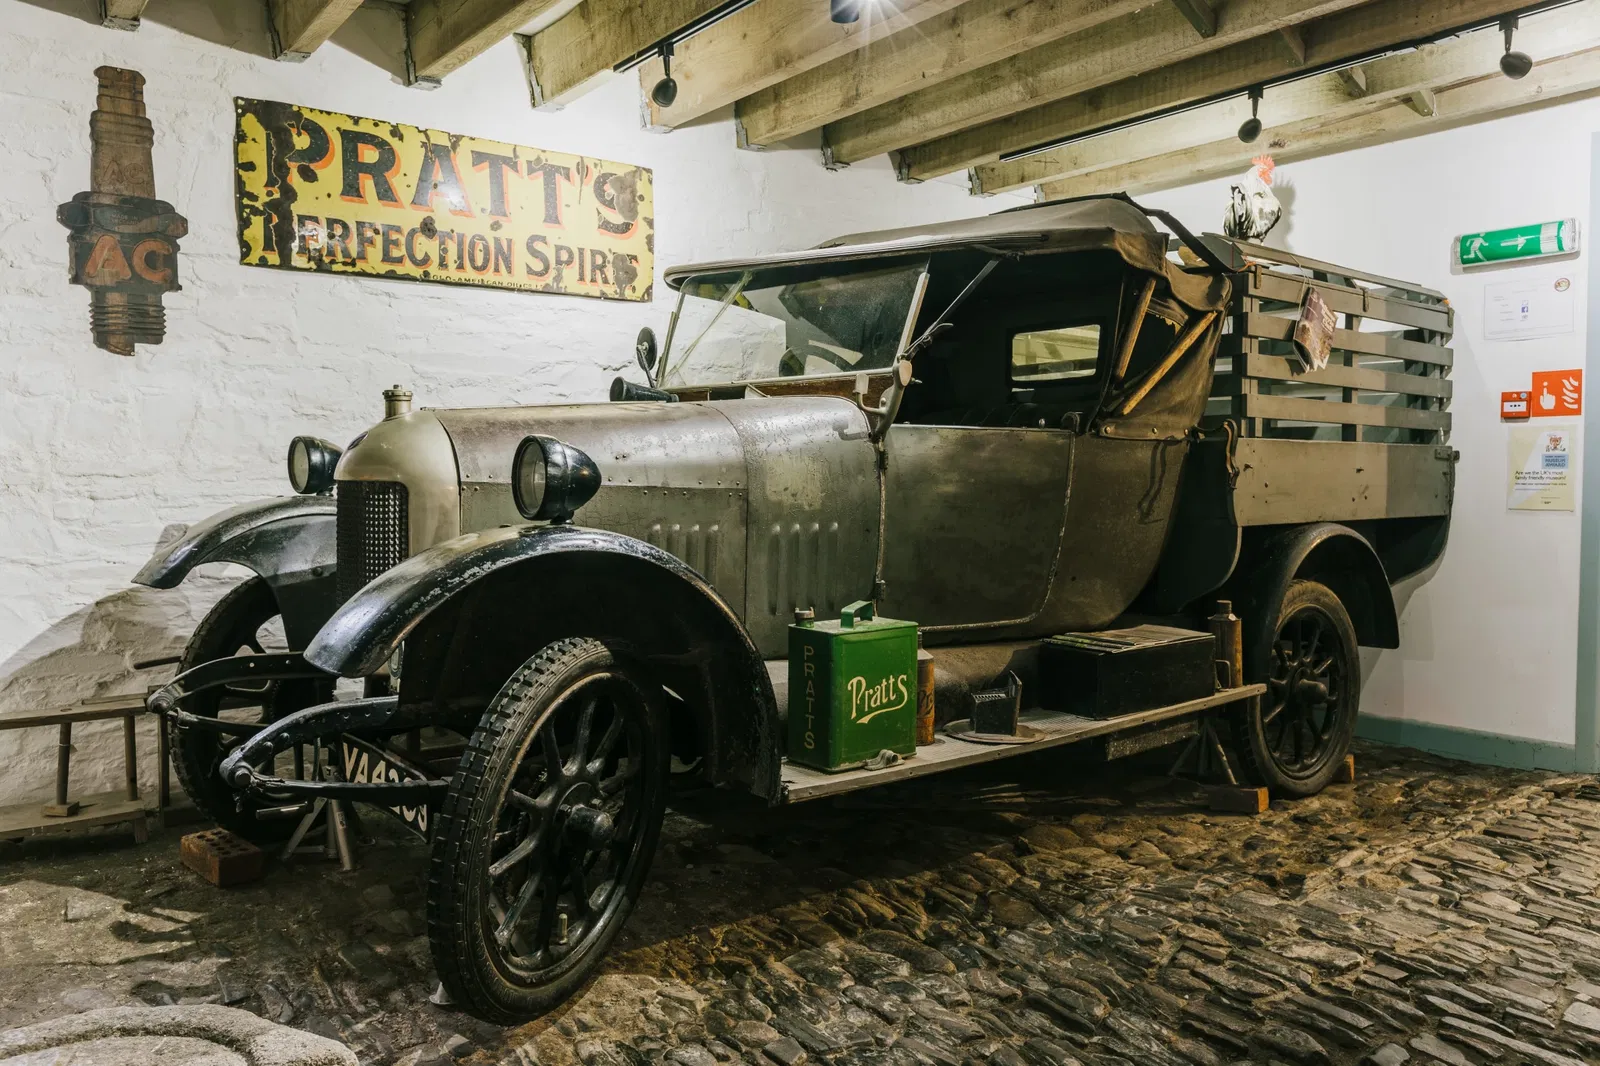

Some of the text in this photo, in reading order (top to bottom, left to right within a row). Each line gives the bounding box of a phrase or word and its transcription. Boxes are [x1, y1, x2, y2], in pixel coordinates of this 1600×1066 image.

[263, 117, 638, 240] PRATT'S
[85, 235, 173, 285] AC
[525, 234, 640, 289] SPIR
[803, 645, 816, 750] PRATTS
[847, 674, 908, 723] Pratts
